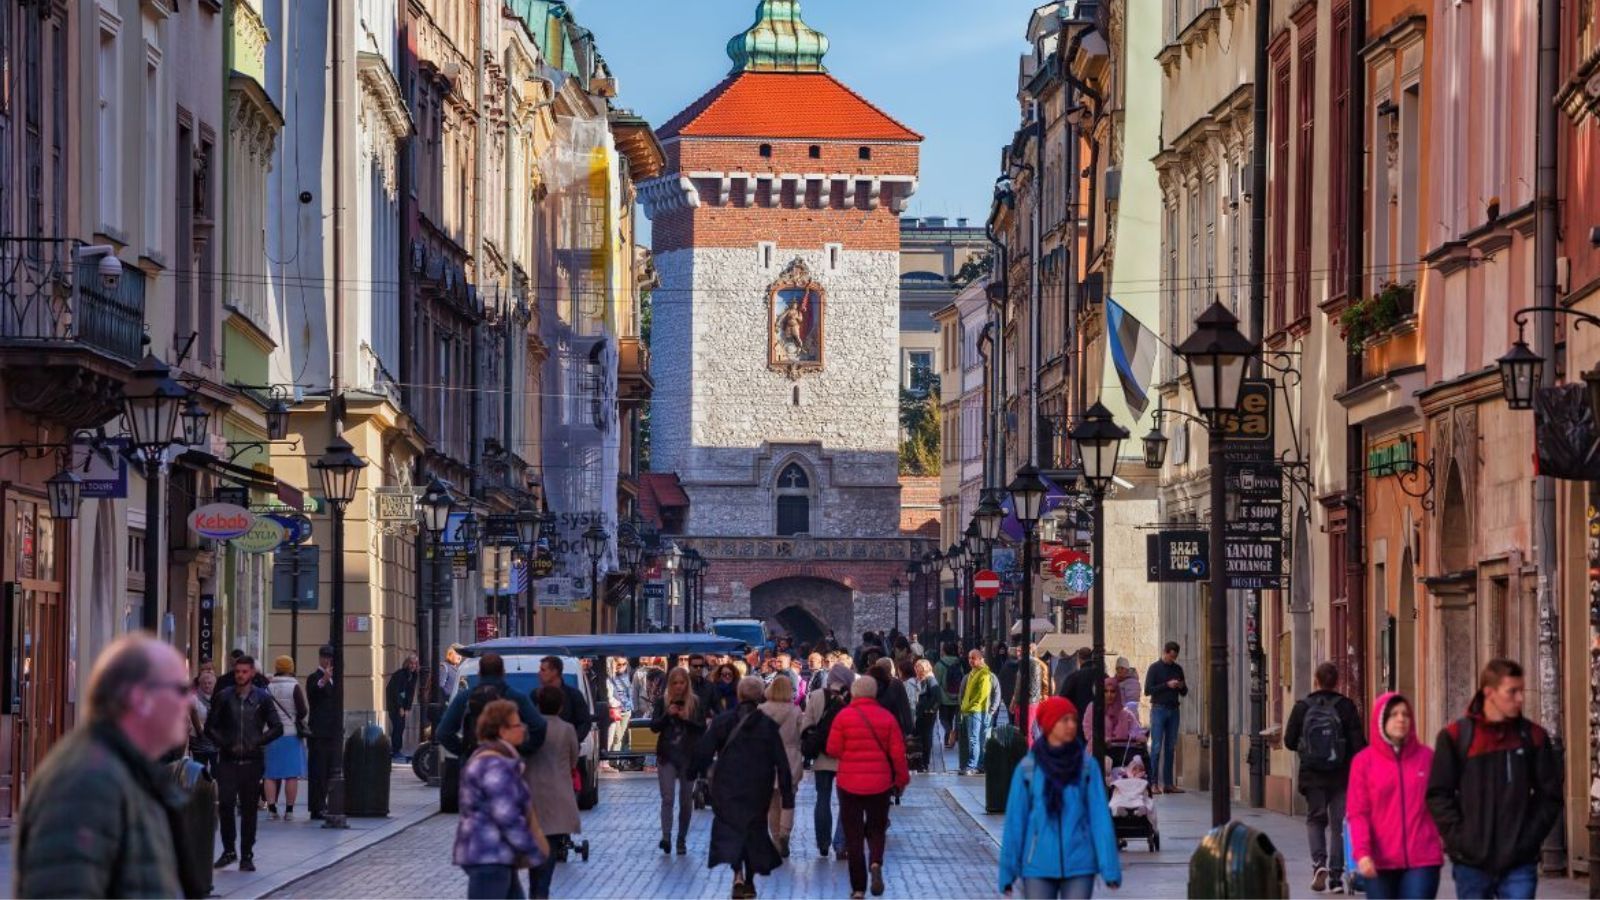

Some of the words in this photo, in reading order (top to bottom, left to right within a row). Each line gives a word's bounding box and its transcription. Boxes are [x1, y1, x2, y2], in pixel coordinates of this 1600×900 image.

[1254, 479, 1279, 488] PINTA
[1251, 506, 1278, 518] SHOP
[195, 512, 248, 529] Kebab
[1170, 541, 1199, 555] BAZA
[1170, 556, 1190, 570] PUB
[1231, 577, 1262, 588] HOSTEL
